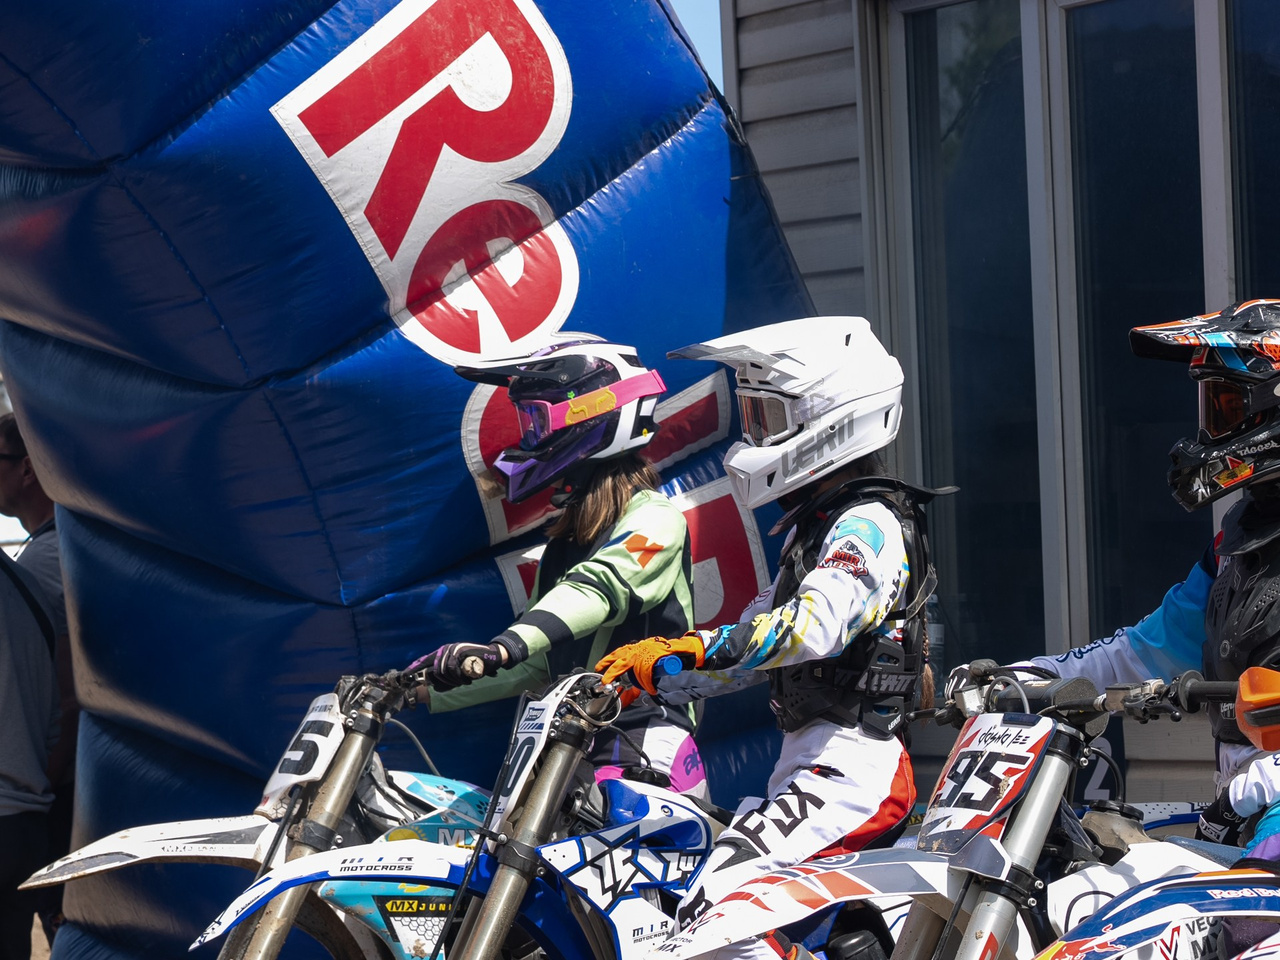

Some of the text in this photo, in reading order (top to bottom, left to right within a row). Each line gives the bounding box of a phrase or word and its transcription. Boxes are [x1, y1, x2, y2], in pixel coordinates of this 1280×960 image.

[781, 408, 859, 478] LEATT
[928, 750, 1032, 812] 95
[389, 900, 418, 912] MX
[632, 930, 670, 944] MOTOCROSS
